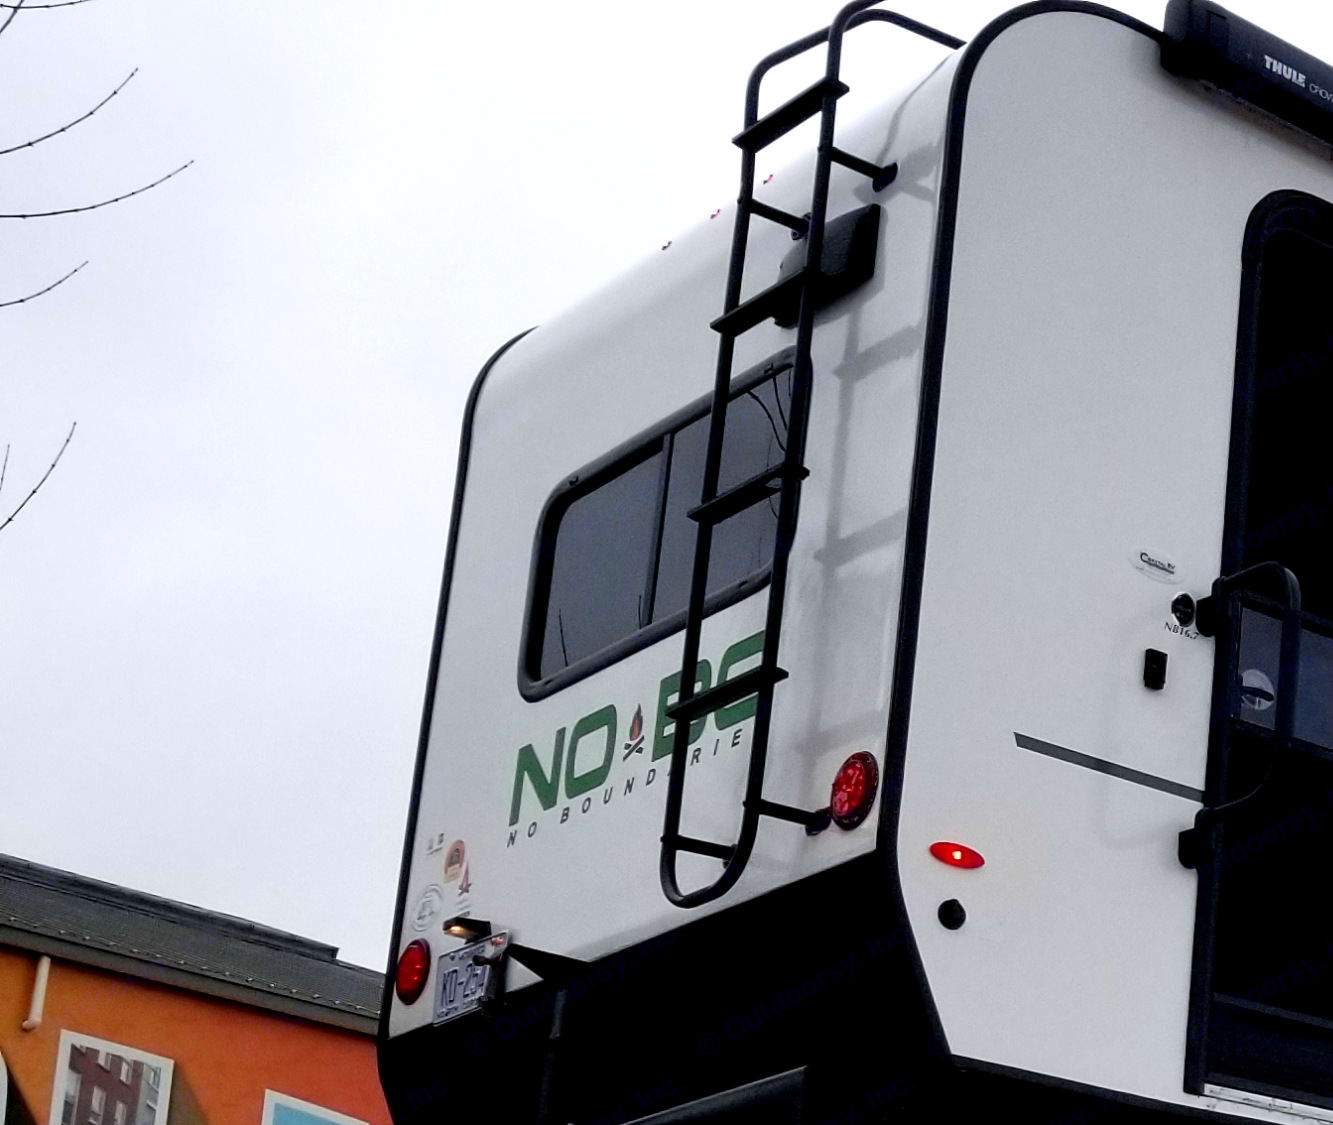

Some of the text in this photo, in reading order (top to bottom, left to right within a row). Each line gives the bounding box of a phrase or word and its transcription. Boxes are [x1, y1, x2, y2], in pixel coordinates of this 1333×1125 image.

[1264, 54, 1306, 88] THULE
[1164, 621, 1200, 640] NB16.7
[506, 728, 743, 848] NO BOUNDRIE
[508, 703, 618, 827] NO
